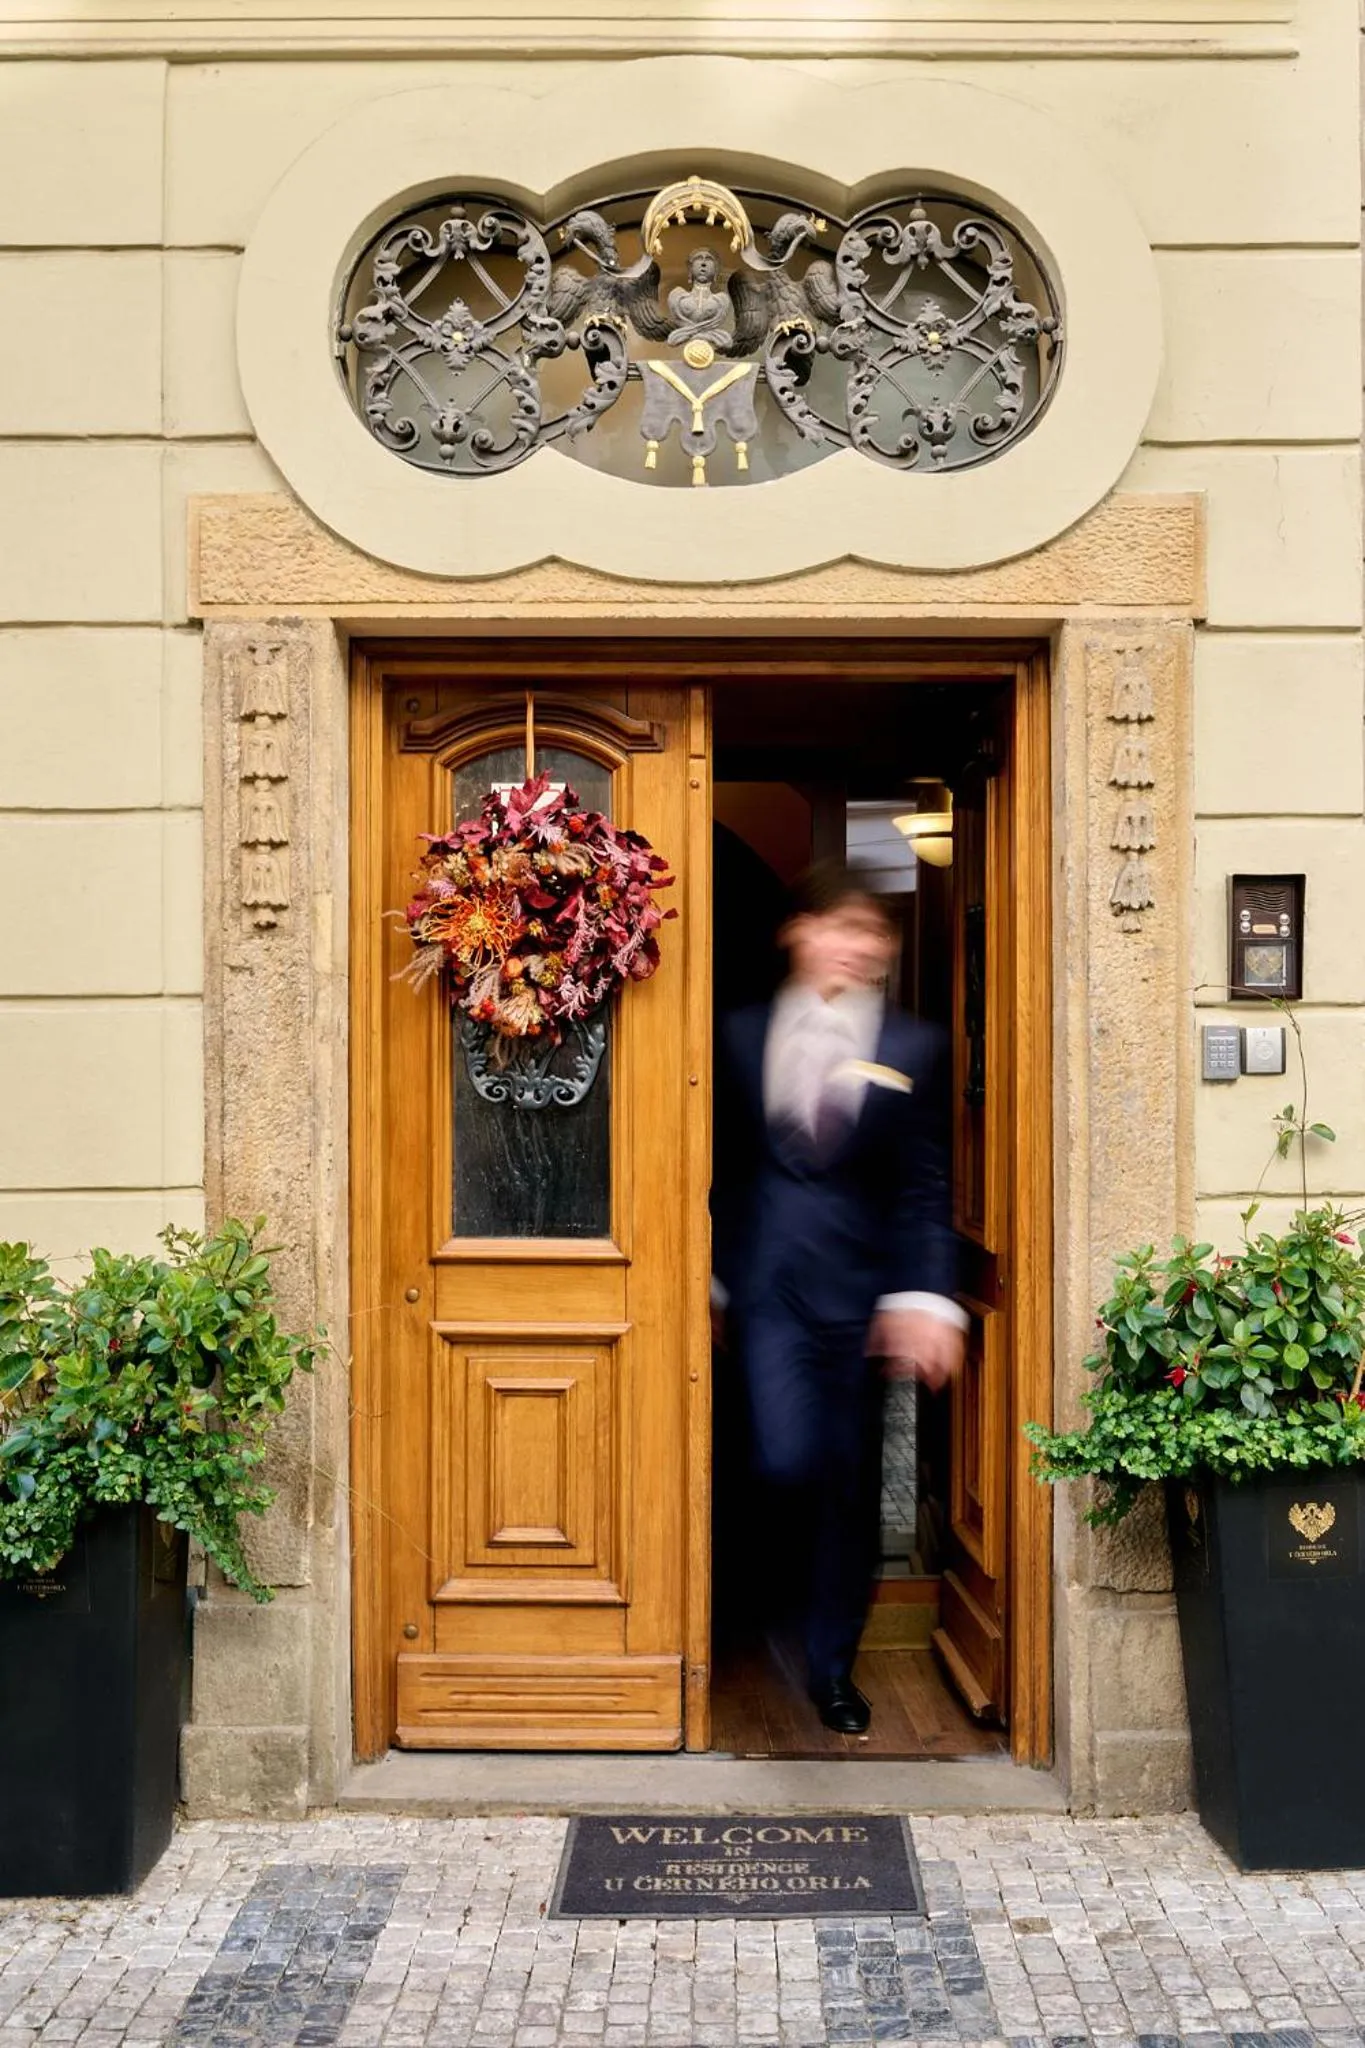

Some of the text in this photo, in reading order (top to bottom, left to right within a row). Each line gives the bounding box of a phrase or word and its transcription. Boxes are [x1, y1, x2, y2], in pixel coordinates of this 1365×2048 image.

[609, 1826, 869, 1845] WELCOME
[723, 1845, 752, 1857] IN
[664, 1862, 810, 1876] RESIDENCE
[604, 1877, 624, 1892] U
[786, 1875, 873, 1890] ORLA
